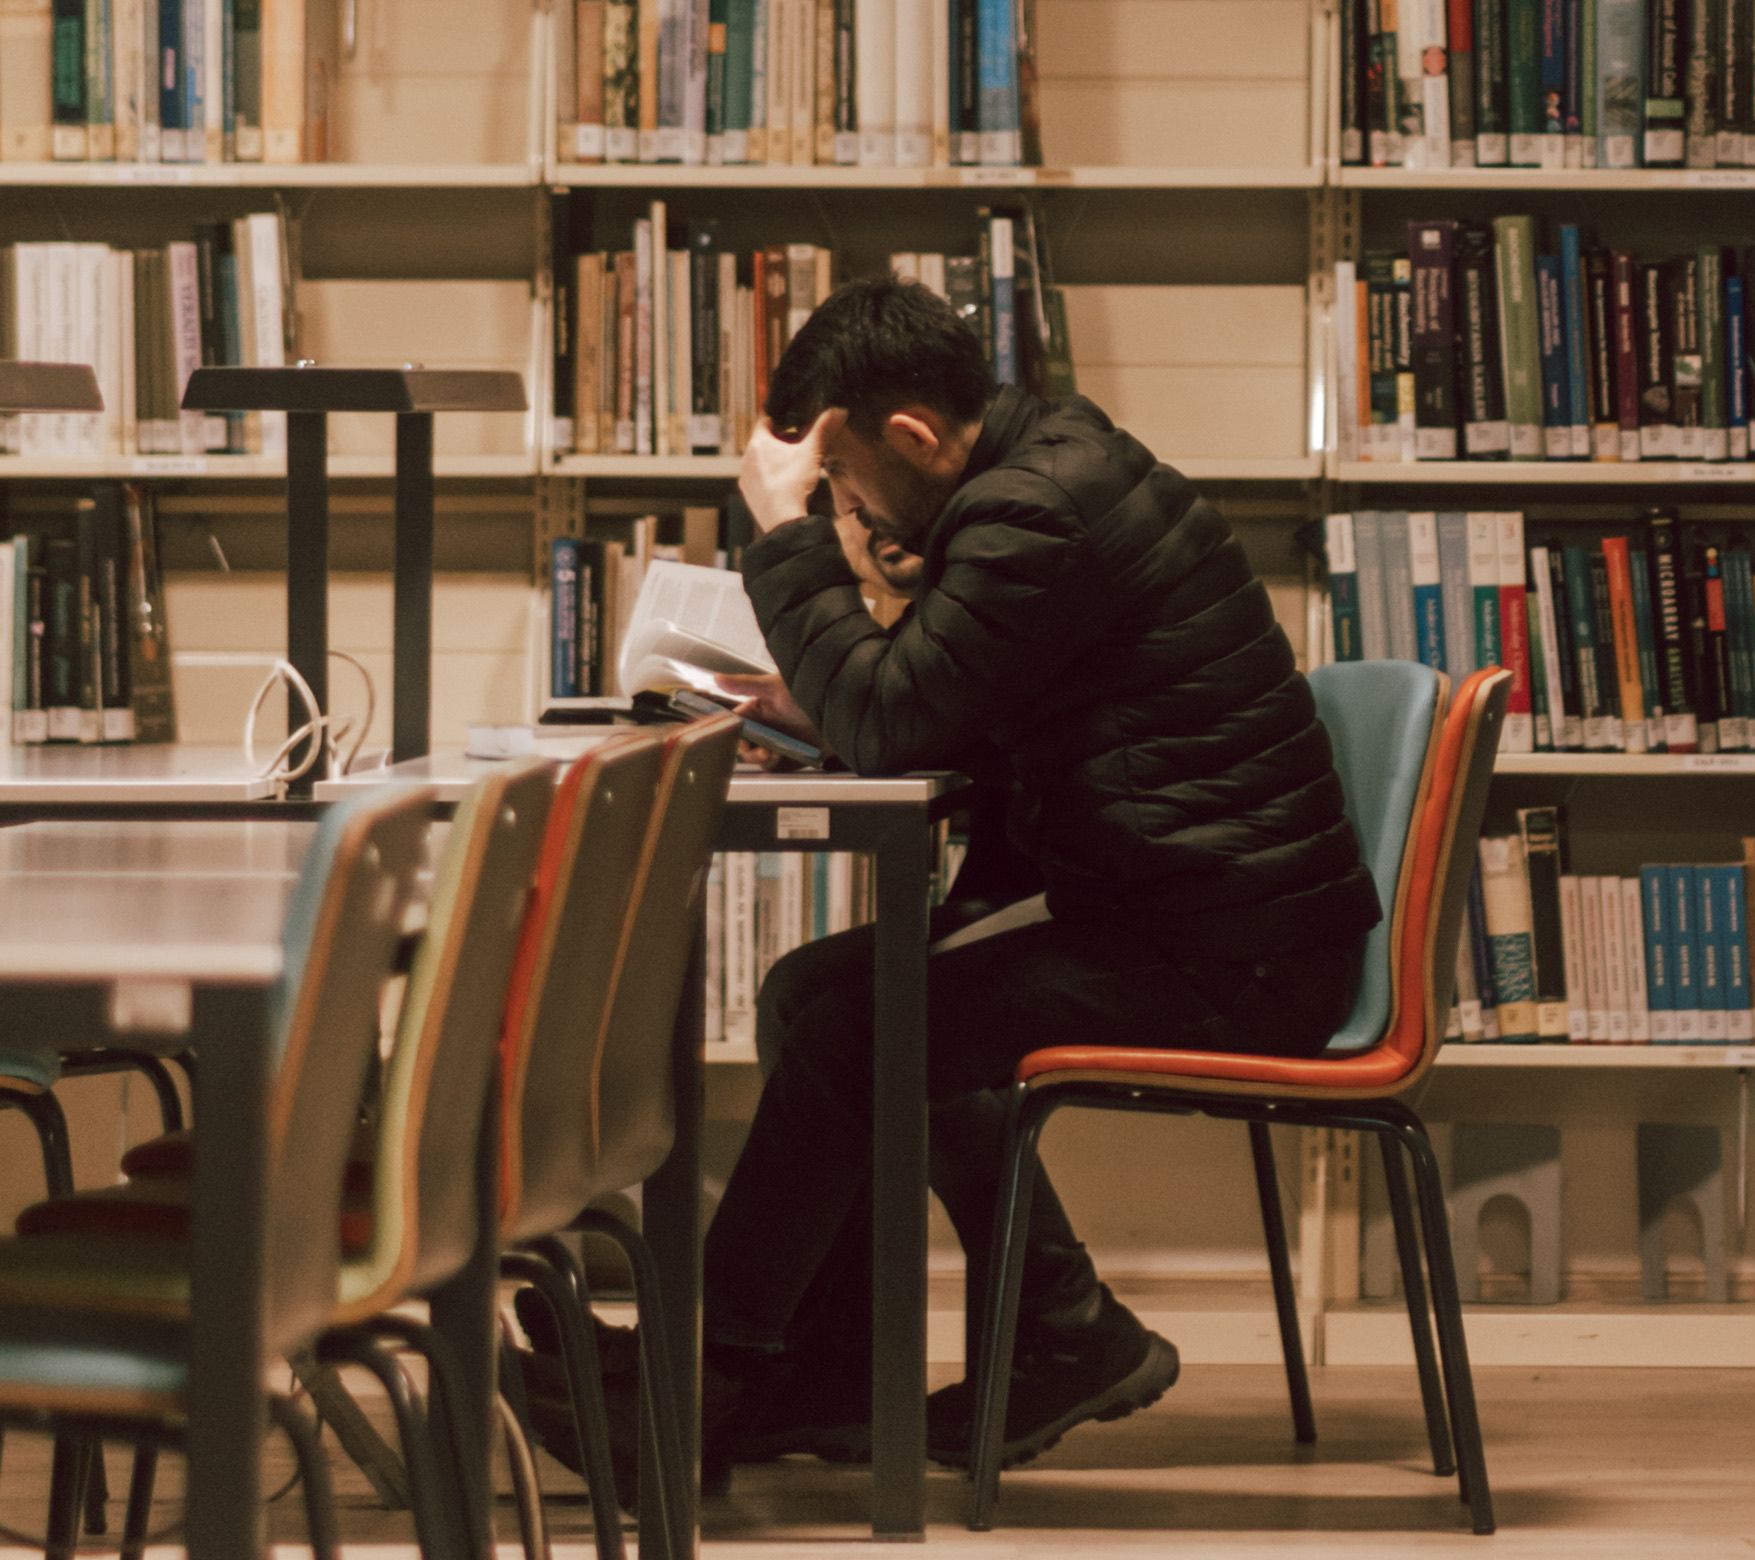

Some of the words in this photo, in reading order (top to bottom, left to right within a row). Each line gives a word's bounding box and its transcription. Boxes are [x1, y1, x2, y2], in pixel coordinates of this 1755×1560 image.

[1398, 291, 1412, 367] Biochemistry
[1658, 553, 1680, 640] MICROARRAY
[1666, 647, 1686, 707] ANALYSIS
